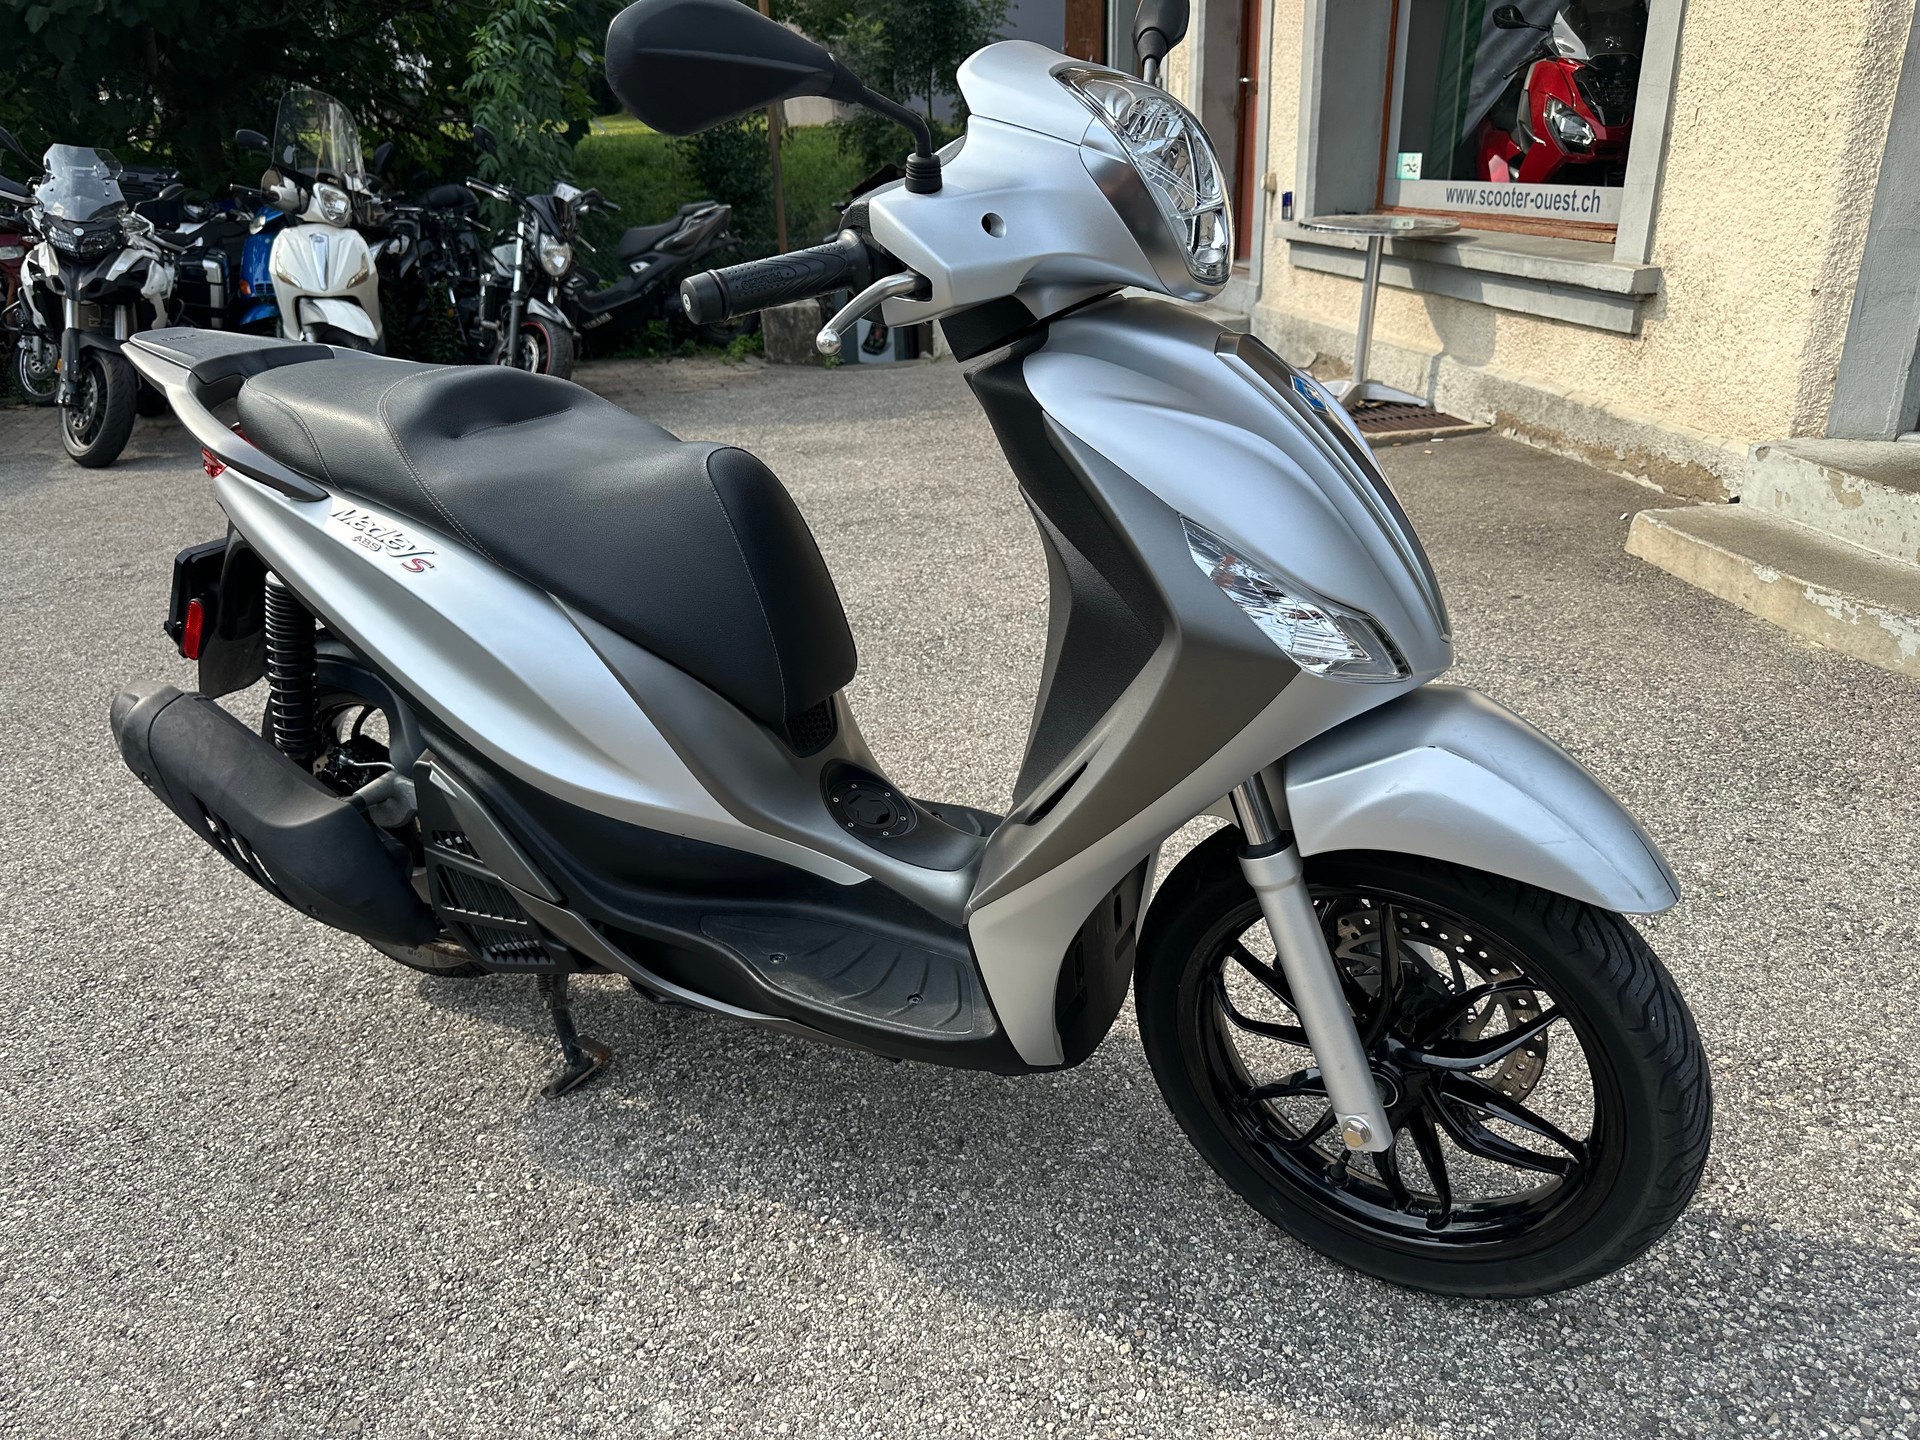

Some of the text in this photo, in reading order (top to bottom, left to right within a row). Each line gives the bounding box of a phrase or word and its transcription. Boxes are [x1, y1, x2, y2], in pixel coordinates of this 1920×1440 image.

[1446, 187, 1601, 213] www.scooter-ouest.ch
[330, 509, 436, 573] Medley S
[352, 535, 382, 552] ABS
